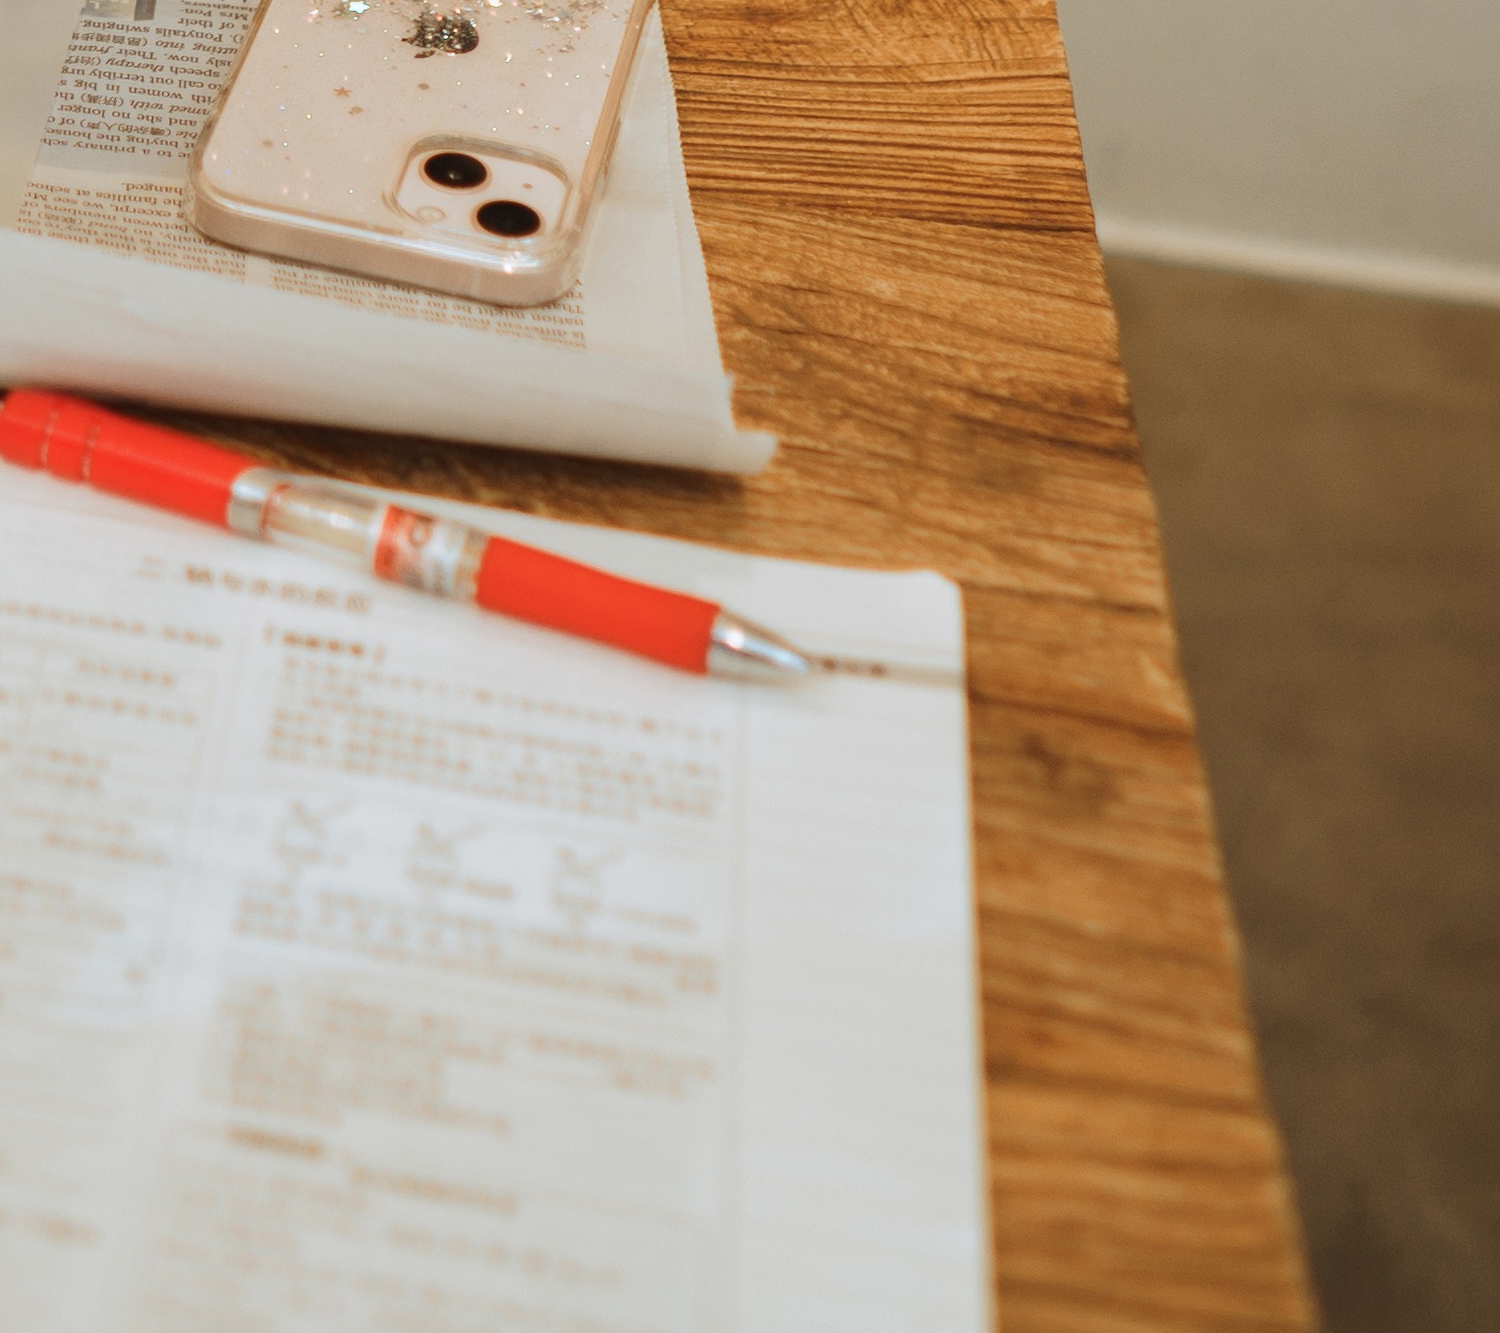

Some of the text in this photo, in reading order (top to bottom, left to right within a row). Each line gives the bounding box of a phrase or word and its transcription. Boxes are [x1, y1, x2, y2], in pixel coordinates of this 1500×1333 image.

[219, 12, 248, 21] Mrs
[178, 18, 213, 28] their
[79, 20, 222, 42] Ponytails swinging.
[155, 40, 184, 51] into
[116, 49, 156, 61] Their
[164, 54, 199, 64] now.
[105, 58, 164, 73] therapy
[89, 69, 145, 84] terribly
[170, 66, 220, 78] speech
[73, 79, 97, 91] big
[149, 76, 174, 85] out
[178, 79, 204, 89] call
[106, 84, 120, 94] in
[128, 86, 182, 101] women
[129, 99, 164, 111] with
[56, 104, 197, 127] and she no longer
[58, 117, 75, 126] of
[96, 133, 121, 142] the
[125, 135, 179, 149] buying
[72, 141, 136, 153] primary
[156, 150, 172, 158] to
[75, 189, 90, 197] at
[53, 197, 78, 205] see
[95, 192, 158, 206] families
[82, 201, 104, 209] we
[19, 209, 31, 217] is
[44, 204, 116, 221] members
[110, 204, 171, 218] excerpt,
[87, 222, 127, 233] bond
[123, 217, 189, 233] between
[104, 232, 135, 242] that
[133, 228, 152, 236] no
[95, 238, 137, 251] thing
[157, 241, 226, 257] common
[144, 247, 177, 257] only
[182, 255, 208, 264] the
[272, 276, 373, 299] complicated
[376, 293, 419, 306] more
[426, 301, 447, 309] far
[453, 305, 472, 315] be
[477, 307, 525, 320] might
